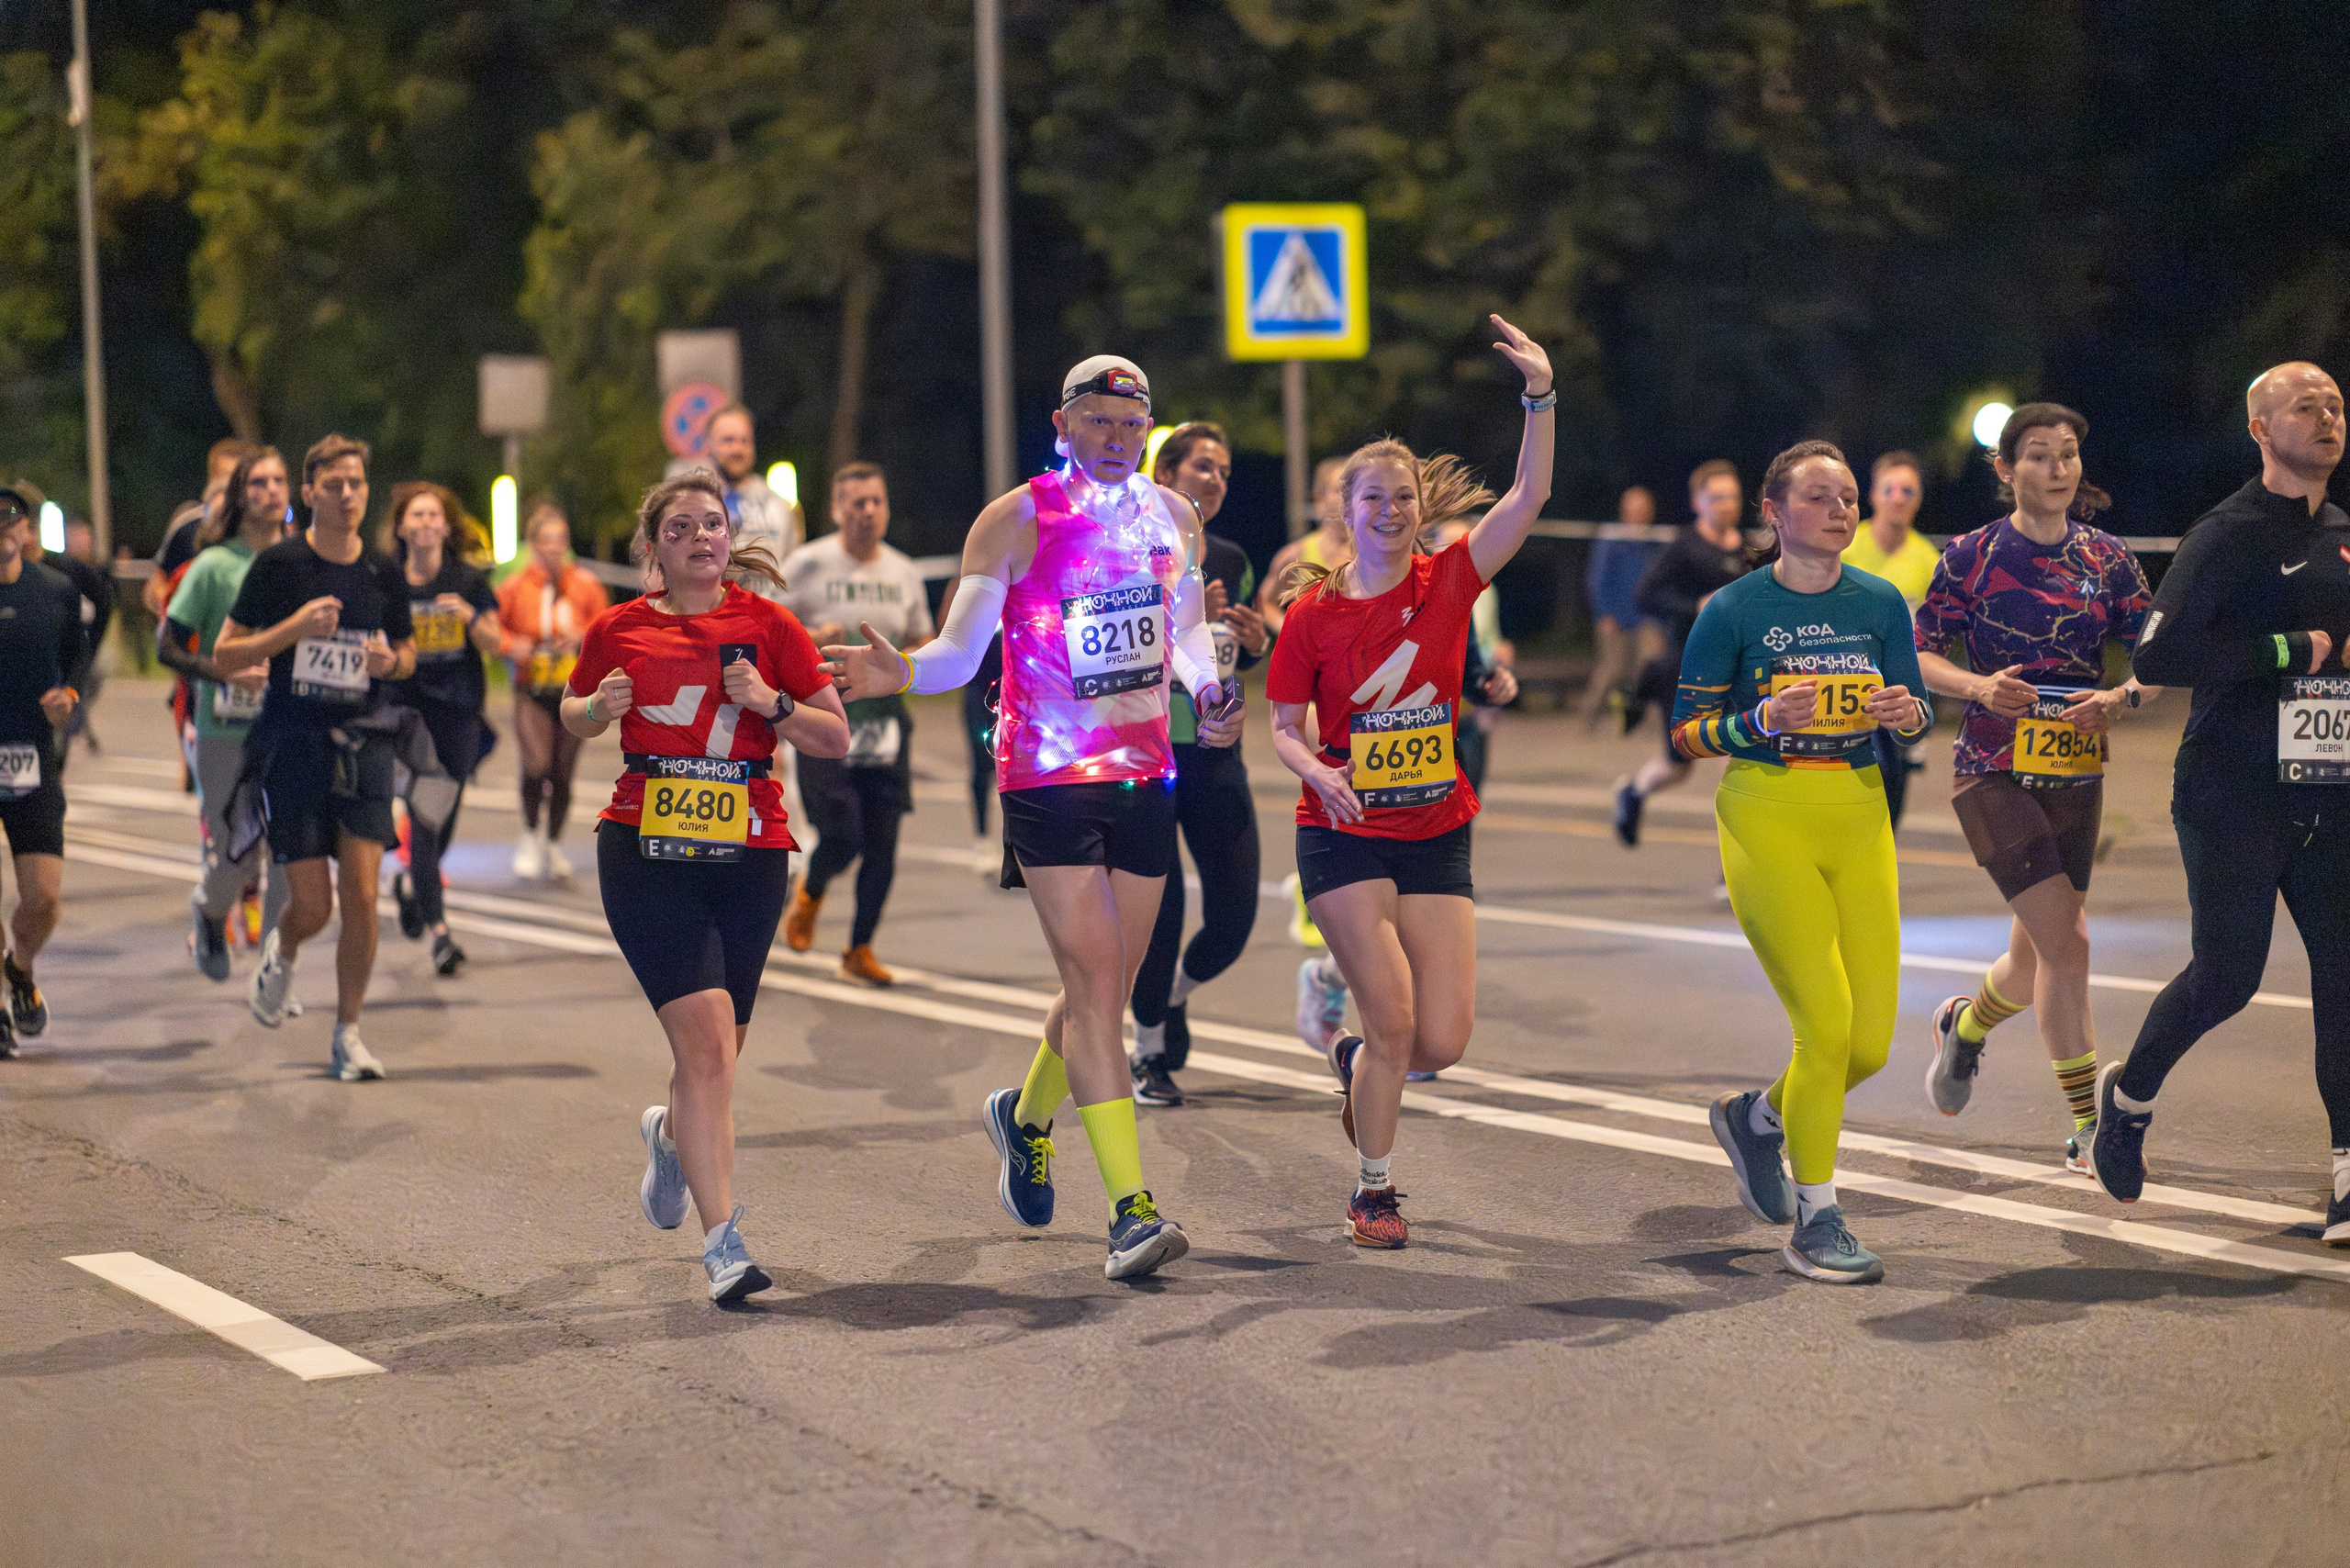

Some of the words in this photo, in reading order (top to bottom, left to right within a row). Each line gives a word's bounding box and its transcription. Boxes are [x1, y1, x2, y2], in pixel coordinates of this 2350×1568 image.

[1080, 616, 1155, 656] 8218
[1796, 623, 1835, 638] КОД
[1799, 634, 1873, 646] безопасности
[308, 644, 364, 674] 7419
[1105, 652, 1141, 666] РУСЛАН
[1779, 736, 1792, 752] F
[2022, 727, 2097, 757] 12854
[2315, 744, 2343, 753] ЛЕВОН
[1366, 734, 1442, 771] 6693
[1390, 770, 1423, 782] ДАРЬЯ
[655, 787, 735, 823] 8480
[1364, 792, 1376, 806] F
[677, 822, 709, 833] ЮЛИЯ
[649, 839, 660, 857] E
